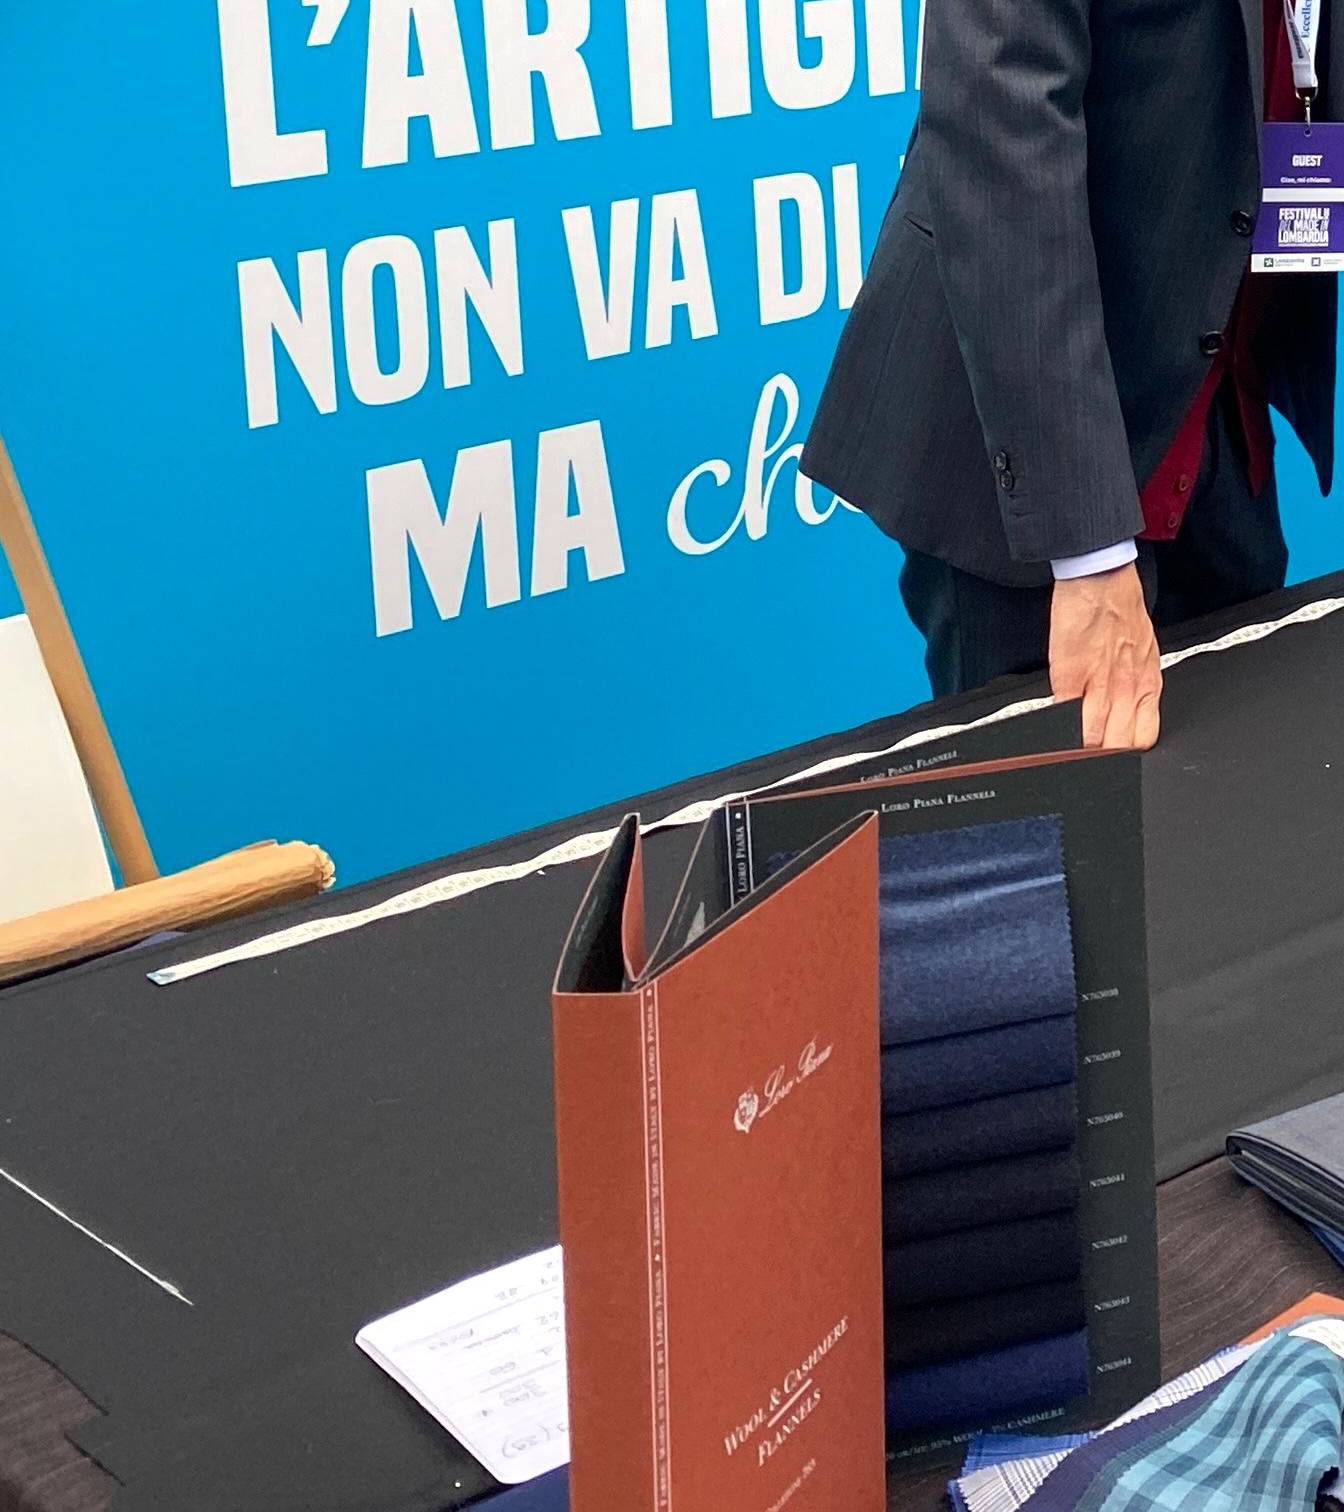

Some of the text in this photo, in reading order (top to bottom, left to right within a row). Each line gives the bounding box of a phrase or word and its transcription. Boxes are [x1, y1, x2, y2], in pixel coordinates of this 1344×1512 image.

[1292, 154, 1323, 167] GUEST
[237, 163, 863, 429] NON VA DI
[366, 420, 625, 637] MA
[881, 790, 996, 813] LORO PIANA FLANNELS
[735, 826, 748, 893] LORO PIANA
[724, 1315, 849, 1456] WOOL & CASHMERE
[758, 1389, 821, 1467] FLANNELS
